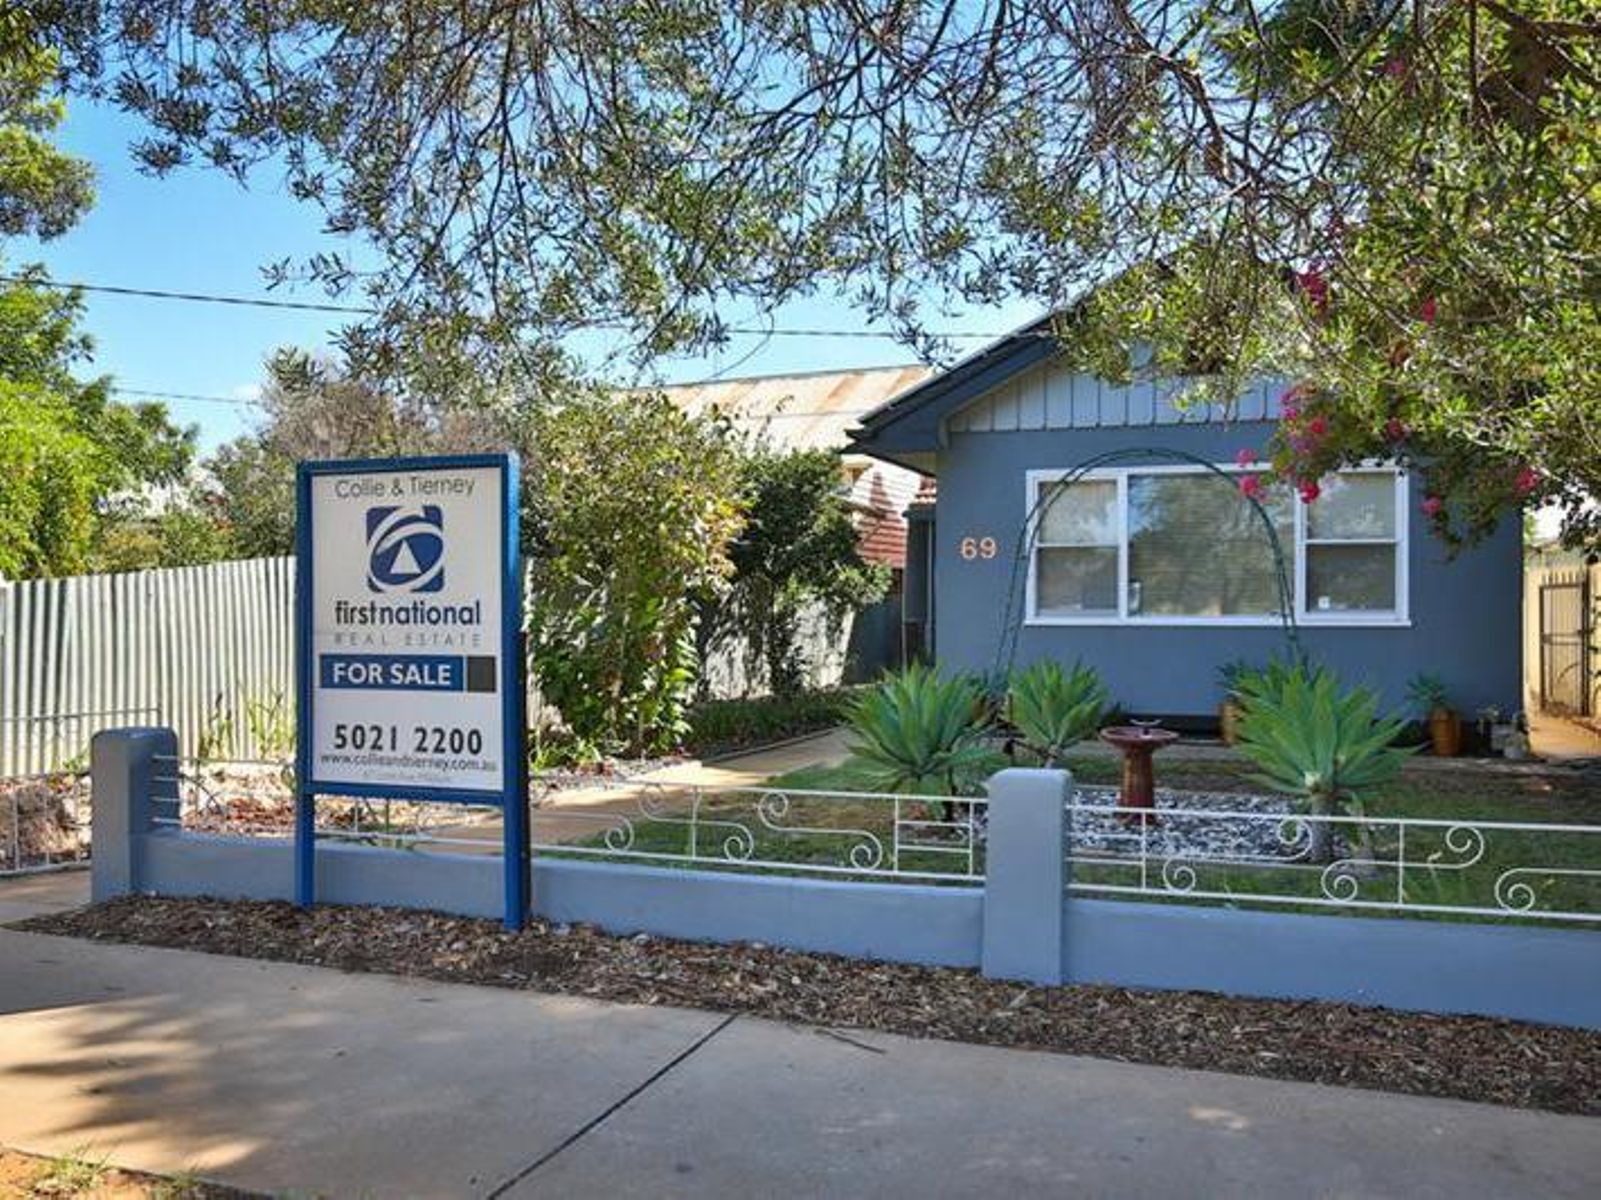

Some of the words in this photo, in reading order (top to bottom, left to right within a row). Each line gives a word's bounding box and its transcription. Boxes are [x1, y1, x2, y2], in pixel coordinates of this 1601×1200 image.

[335, 479, 385, 498] Collie
[391, 478, 403, 496] &
[410, 476, 475, 496] Tierney
[961, 536, 997, 560] 69
[334, 632, 388, 647] REAL
[405, 633, 481, 648] ESTATE
[332, 662, 383, 684] FOR
[390, 663, 451, 686] SALE
[334, 724, 398, 751] 5021
[415, 727, 483, 755] 2200
